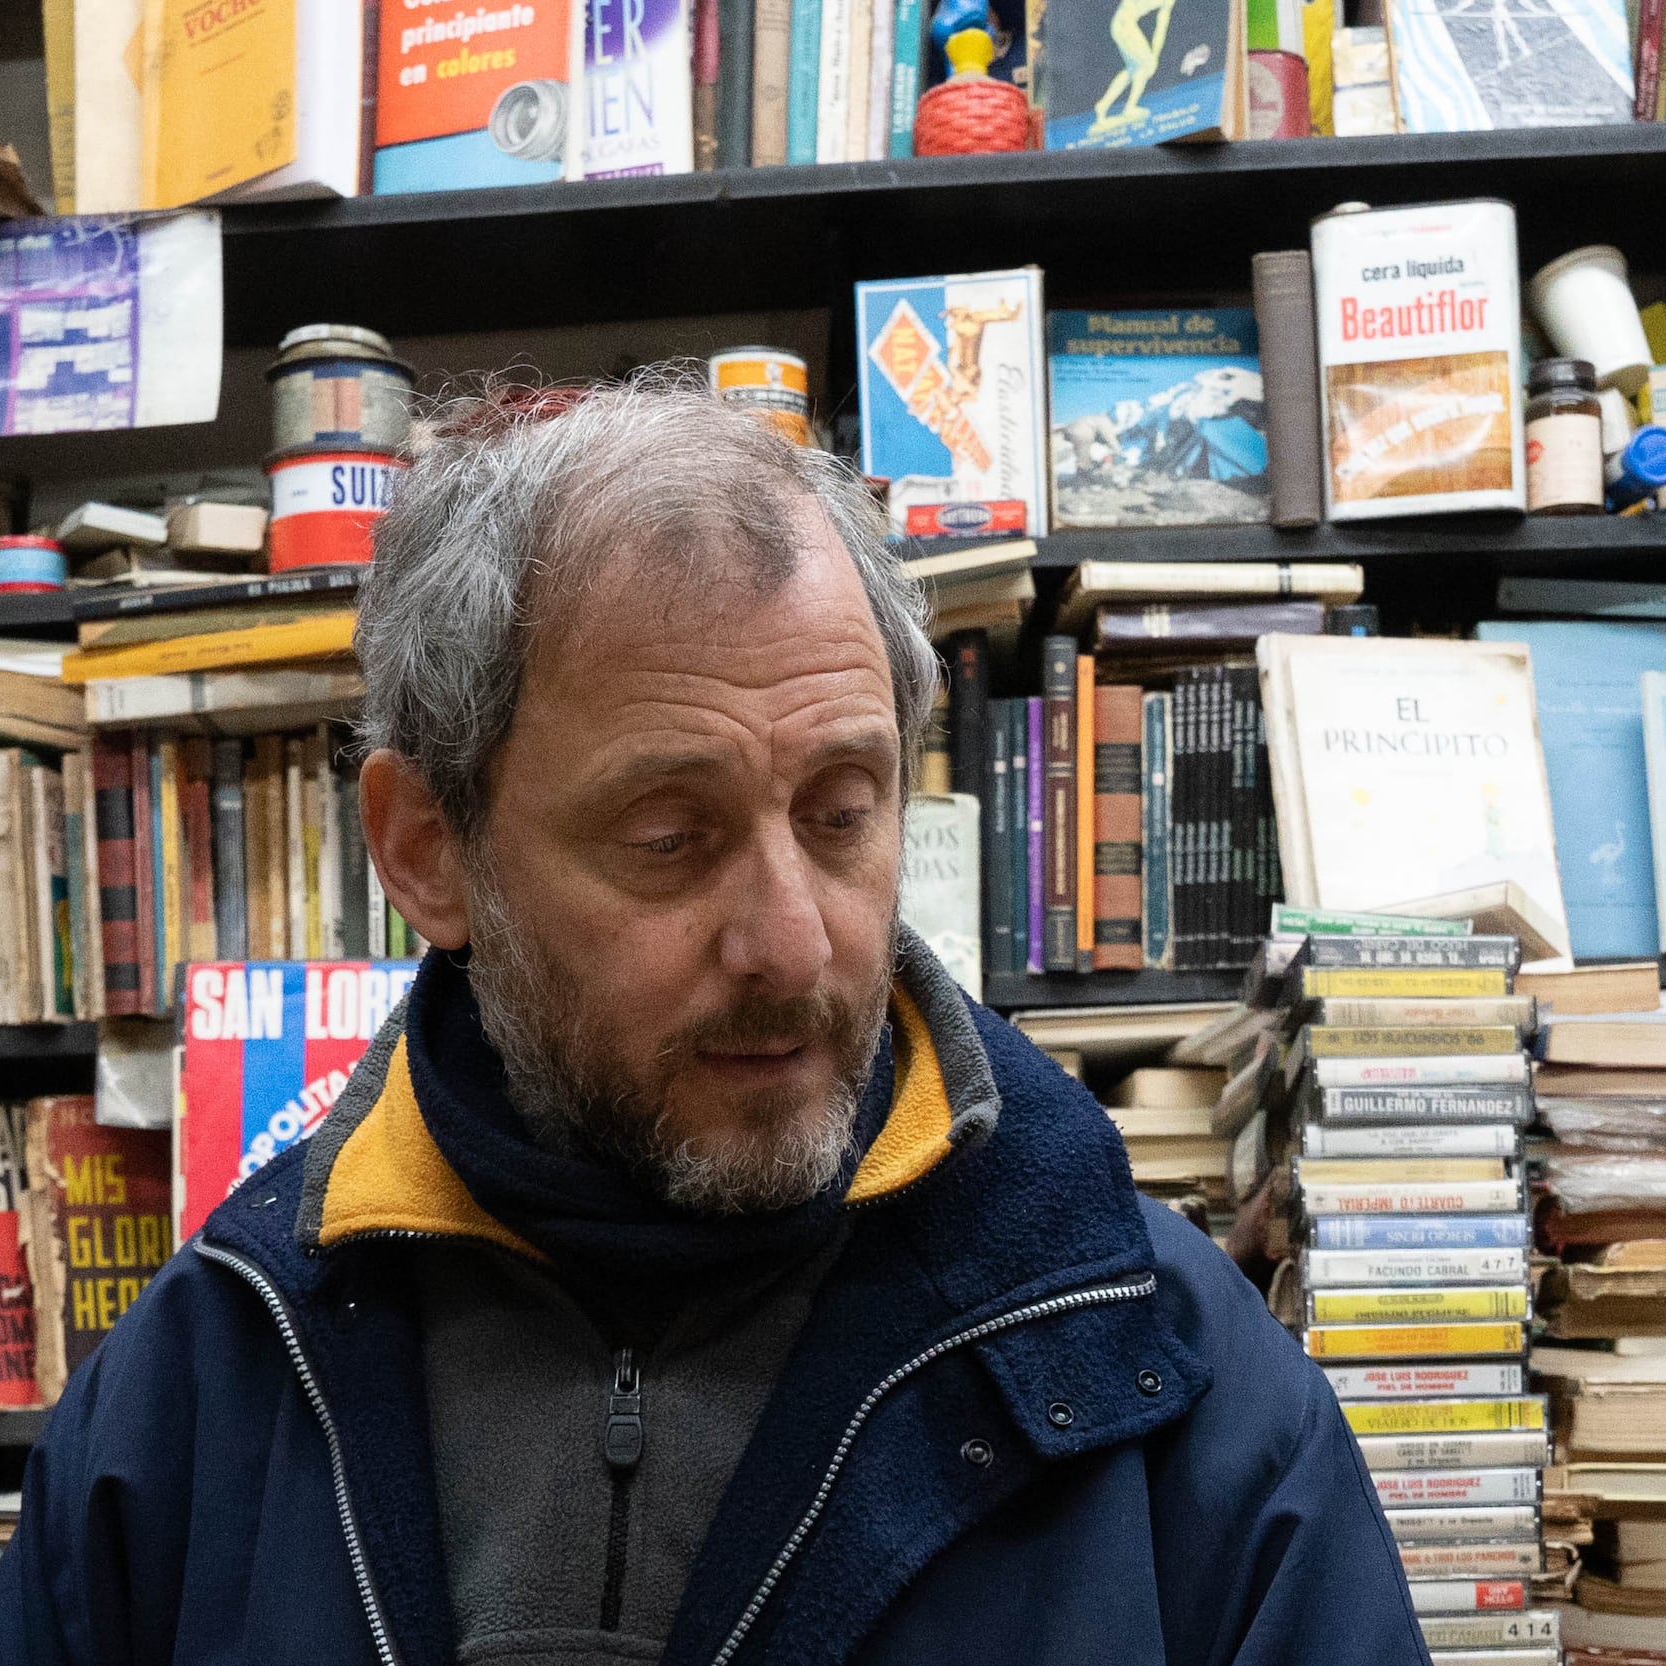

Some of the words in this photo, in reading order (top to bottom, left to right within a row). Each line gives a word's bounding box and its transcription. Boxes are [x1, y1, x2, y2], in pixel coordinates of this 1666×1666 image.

[401, 8, 535, 53] principiante
[398, 63, 428, 87] en
[436, 44, 517, 79] colores
[1362, 261, 1400, 283] cera
[1406, 254, 1466, 282] líquida
[1340, 292, 1489, 342] Beautiflor
[1067, 331, 1241, 356] supervivencia
[1396, 697, 1431, 723] EL
[1323, 728, 1509, 758] PRINCIPITO
[191, 969, 284, 1040] SAN
[1344, 1097, 1426, 1113] GUILLERMO
[1432, 1099, 1514, 1114] FERNANDEZ
[64, 1153, 127, 1206] MIS
[1368, 1265, 1422, 1277] FACUNDO
[1427, 1265, 1469, 1276] CABRAL
[1364, 1372, 1387, 1382] JOSE
[1390, 1371, 1411, 1381] LUIS
[1414, 1371, 1469, 1380] RODRIGUEZ
[1403, 1479, 1423, 1489] LUIS
[1426, 1478, 1481, 1488] RODRIGUEZ
[1457, 1553, 1473, 1562] LOS
[1476, 1551, 1516, 1561] PANCHOS
